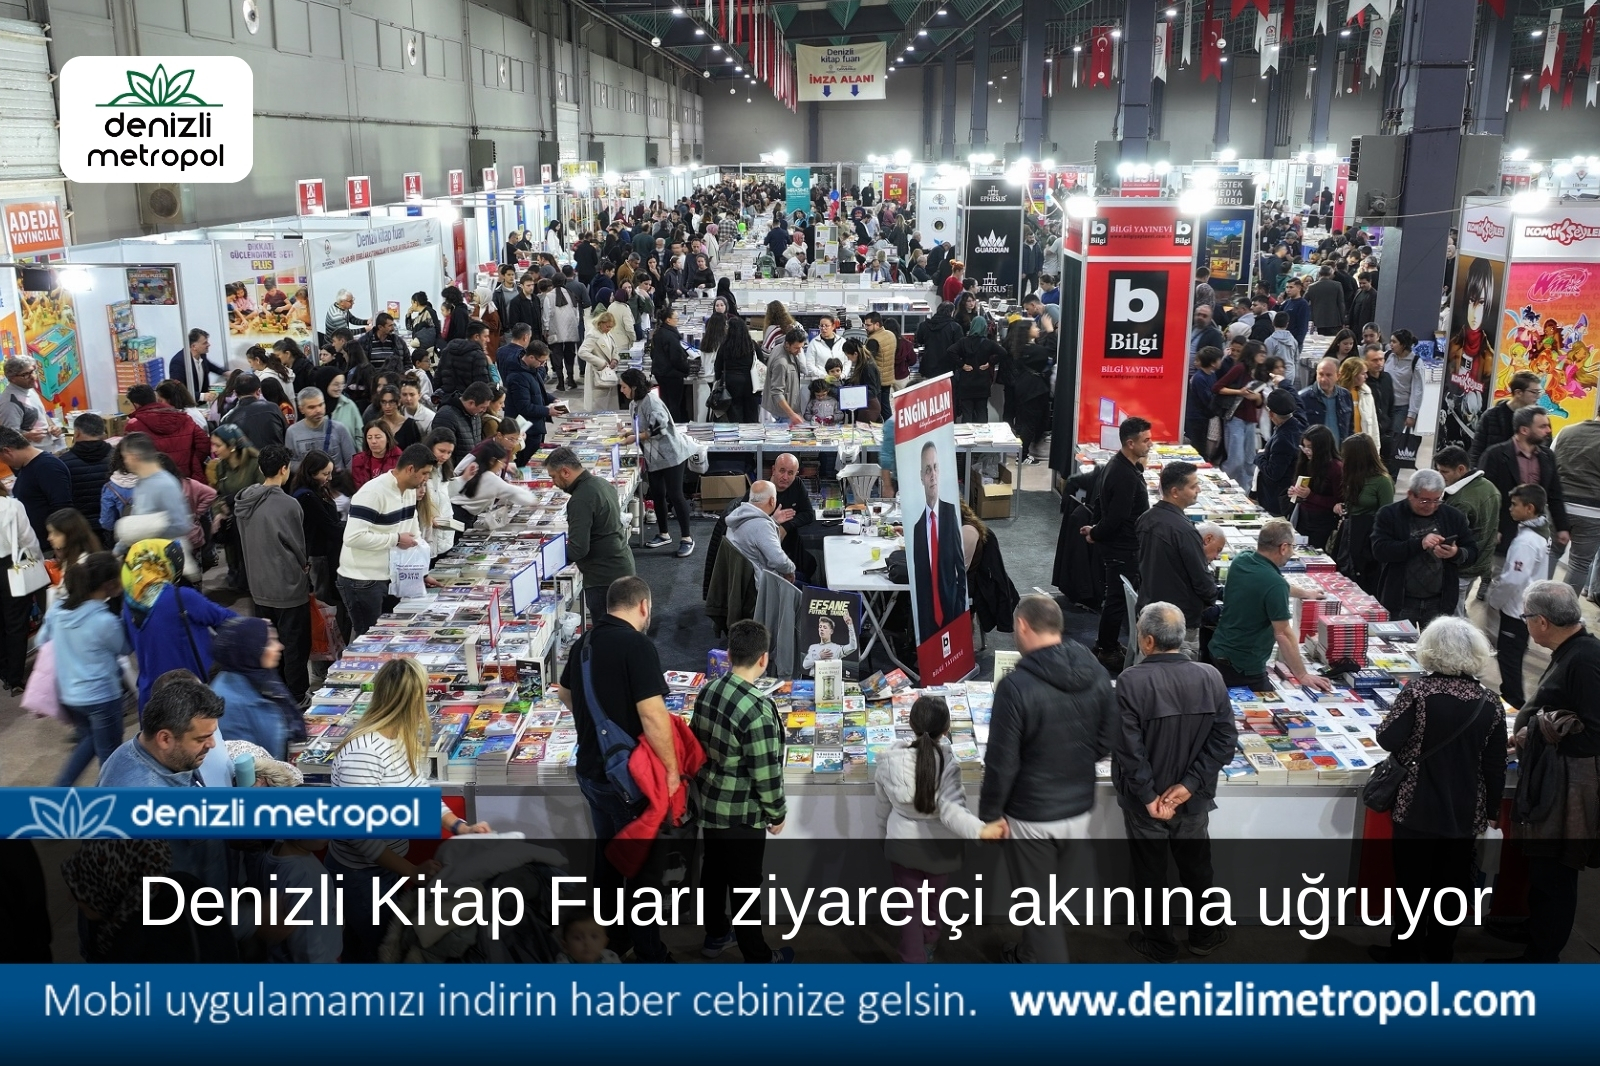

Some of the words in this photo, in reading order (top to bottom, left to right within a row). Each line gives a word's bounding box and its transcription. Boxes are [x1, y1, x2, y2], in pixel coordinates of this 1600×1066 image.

[827, 48, 854, 56] Denizli
[821, 56, 840, 64] kitap
[809, 73, 838, 84] İMZA
[840, 74, 874, 84] ALANI
[9, 209, 59, 232] ADEDA
[1110, 224, 1132, 233] BİLGİ
[1134, 224, 1173, 233] YAYINEVİ
[11, 228, 61, 245] YAYINCILIK
[1090, 237, 1106, 246] Bilgi
[1175, 237, 1191, 246] Bilgi
[975, 246, 1010, 254] GUARDIAN
[253, 260, 273, 270] PLUS
[976, 285, 1006, 293] PHESUS
[1113, 278, 1160, 323] b
[1110, 332, 1158, 355] Bilgi
[1101, 364, 1123, 374] BİLGİ
[1125, 364, 1164, 374] YAYINEVİ
[898, 398, 928, 429] ENGİN
[929, 390, 951, 417] ALAN
[809, 599, 850, 611] EFSANE
